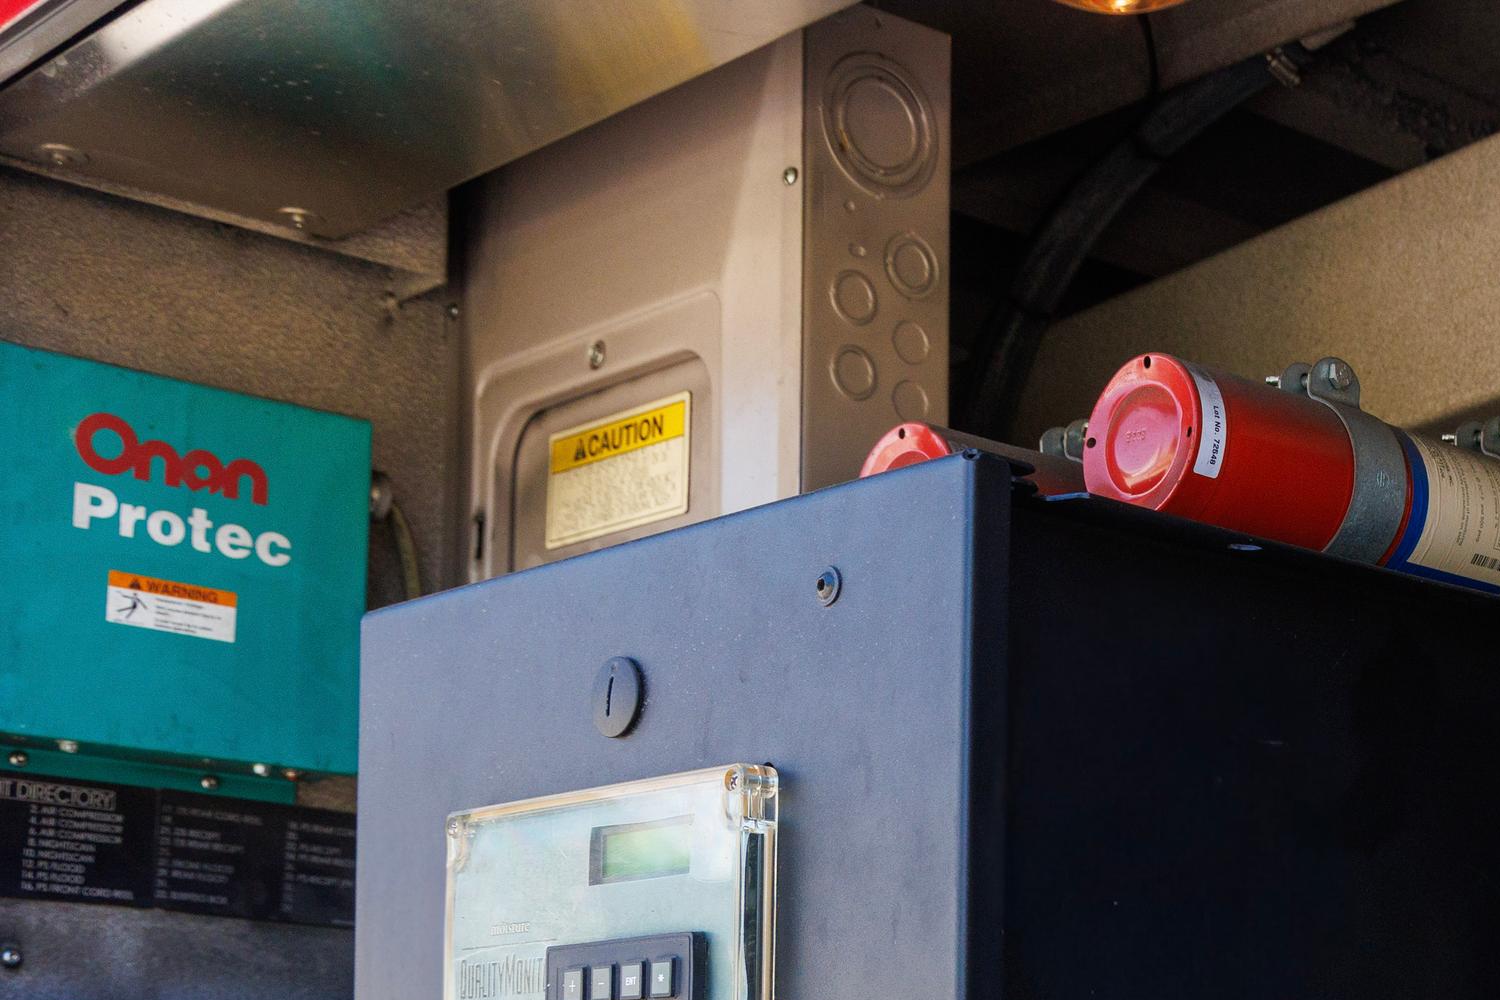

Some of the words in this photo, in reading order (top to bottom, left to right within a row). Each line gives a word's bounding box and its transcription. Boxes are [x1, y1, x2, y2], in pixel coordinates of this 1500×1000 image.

[587, 414, 664, 457] CAUTION
[73, 412, 270, 506] Onan
[72, 481, 292, 568] Protec
[146, 579, 219, 606] WARNING
[16, 782, 114, 809] DIRECTORY
[625, 976, 637, 986] ENT
